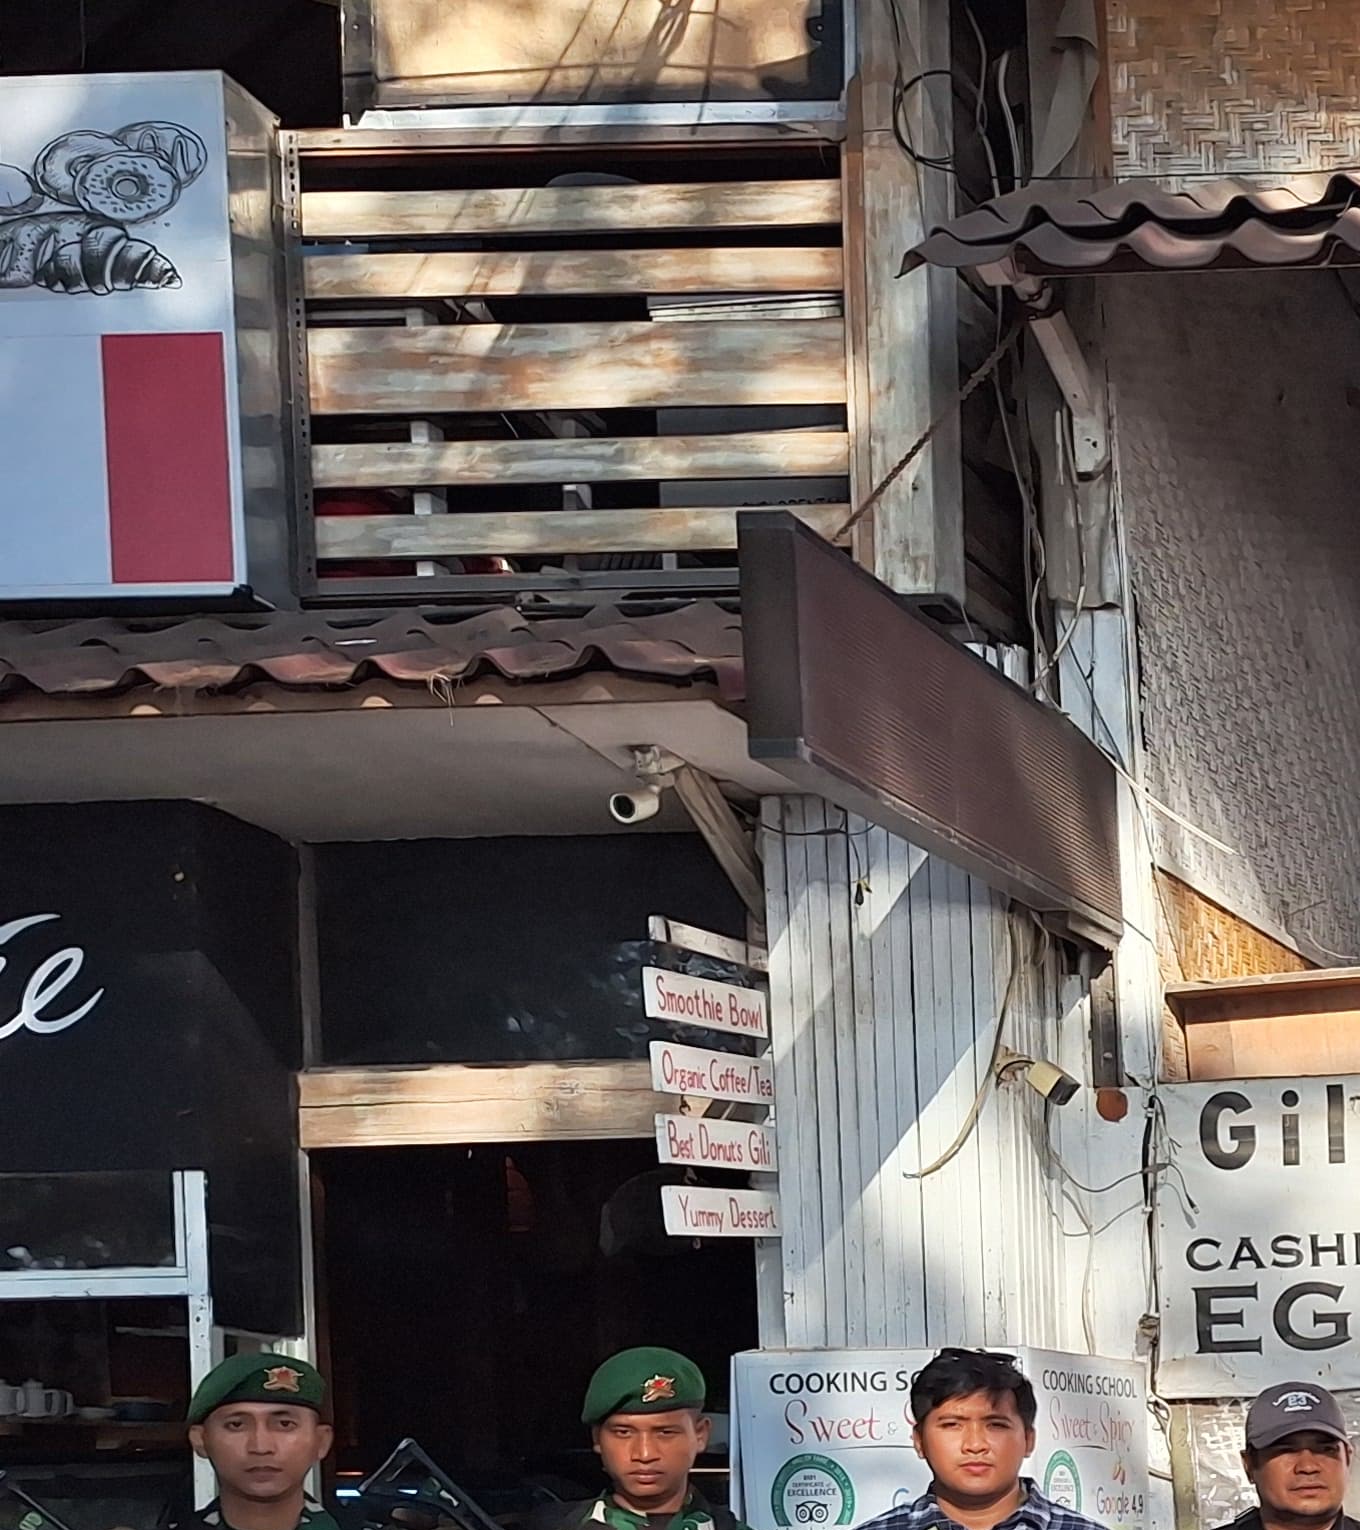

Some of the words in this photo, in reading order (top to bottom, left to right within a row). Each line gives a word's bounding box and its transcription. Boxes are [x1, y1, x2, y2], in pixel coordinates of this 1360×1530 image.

[656, 975, 723, 1022] Smoothie
[728, 992, 763, 1032] Bowl
[662, 1050, 707, 1092] Organic
[709, 1058, 773, 1097] Coffee/Tea
[667, 1120, 695, 1159] Best
[699, 1123, 743, 1162] Donut's
[748, 1130, 771, 1165] Gili
[678, 1195, 724, 1232] Yummy
[729, 1197, 777, 1229] Dessert
[769, 1371, 887, 1394] COOKING
[1042, 1369, 1094, 1395] COOKING
[1095, 1375, 1138, 1398] SCHOOL
[784, 1399, 883, 1445] Sweet
[1049, 1395, 1091, 1441] Sweet
[787, 1488, 837, 1497] EXCELLENCE
